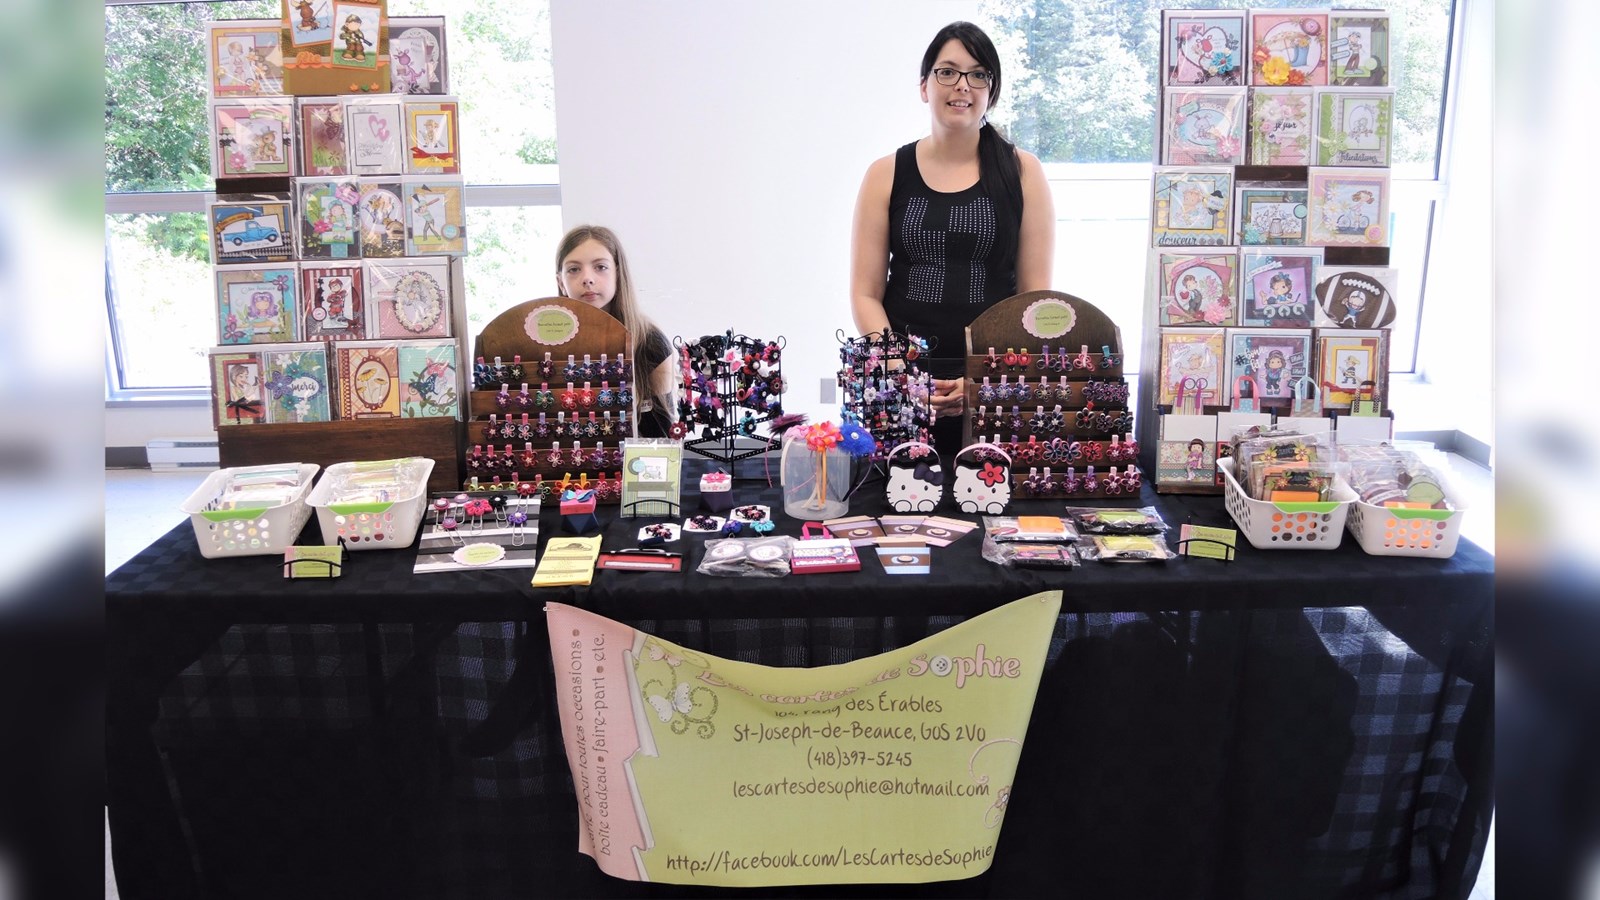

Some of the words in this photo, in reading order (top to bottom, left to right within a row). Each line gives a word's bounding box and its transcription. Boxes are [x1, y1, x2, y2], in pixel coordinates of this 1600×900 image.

[291, 381, 316, 391] merci
[592, 633, 606, 661] etc.
[569, 640, 583, 720] occasions
[592, 677, 608, 754] faire-part
[803, 704, 841, 717] rang
[845, 696, 874, 712] des
[878, 691, 943, 713] Érables
[577, 725, 588, 768] toutes
[733, 721, 916, 746] St-Joseph-de-Beauce,
[807, 746, 913, 770] (418)397-5245
[581, 771, 593, 808] pour
[596, 766, 608, 818] cadeau
[733, 777, 990, 800] lescartesdesophie@hotmail.com
[666, 846, 993, 875] http://facebook.com/LesCartesdeSophie
